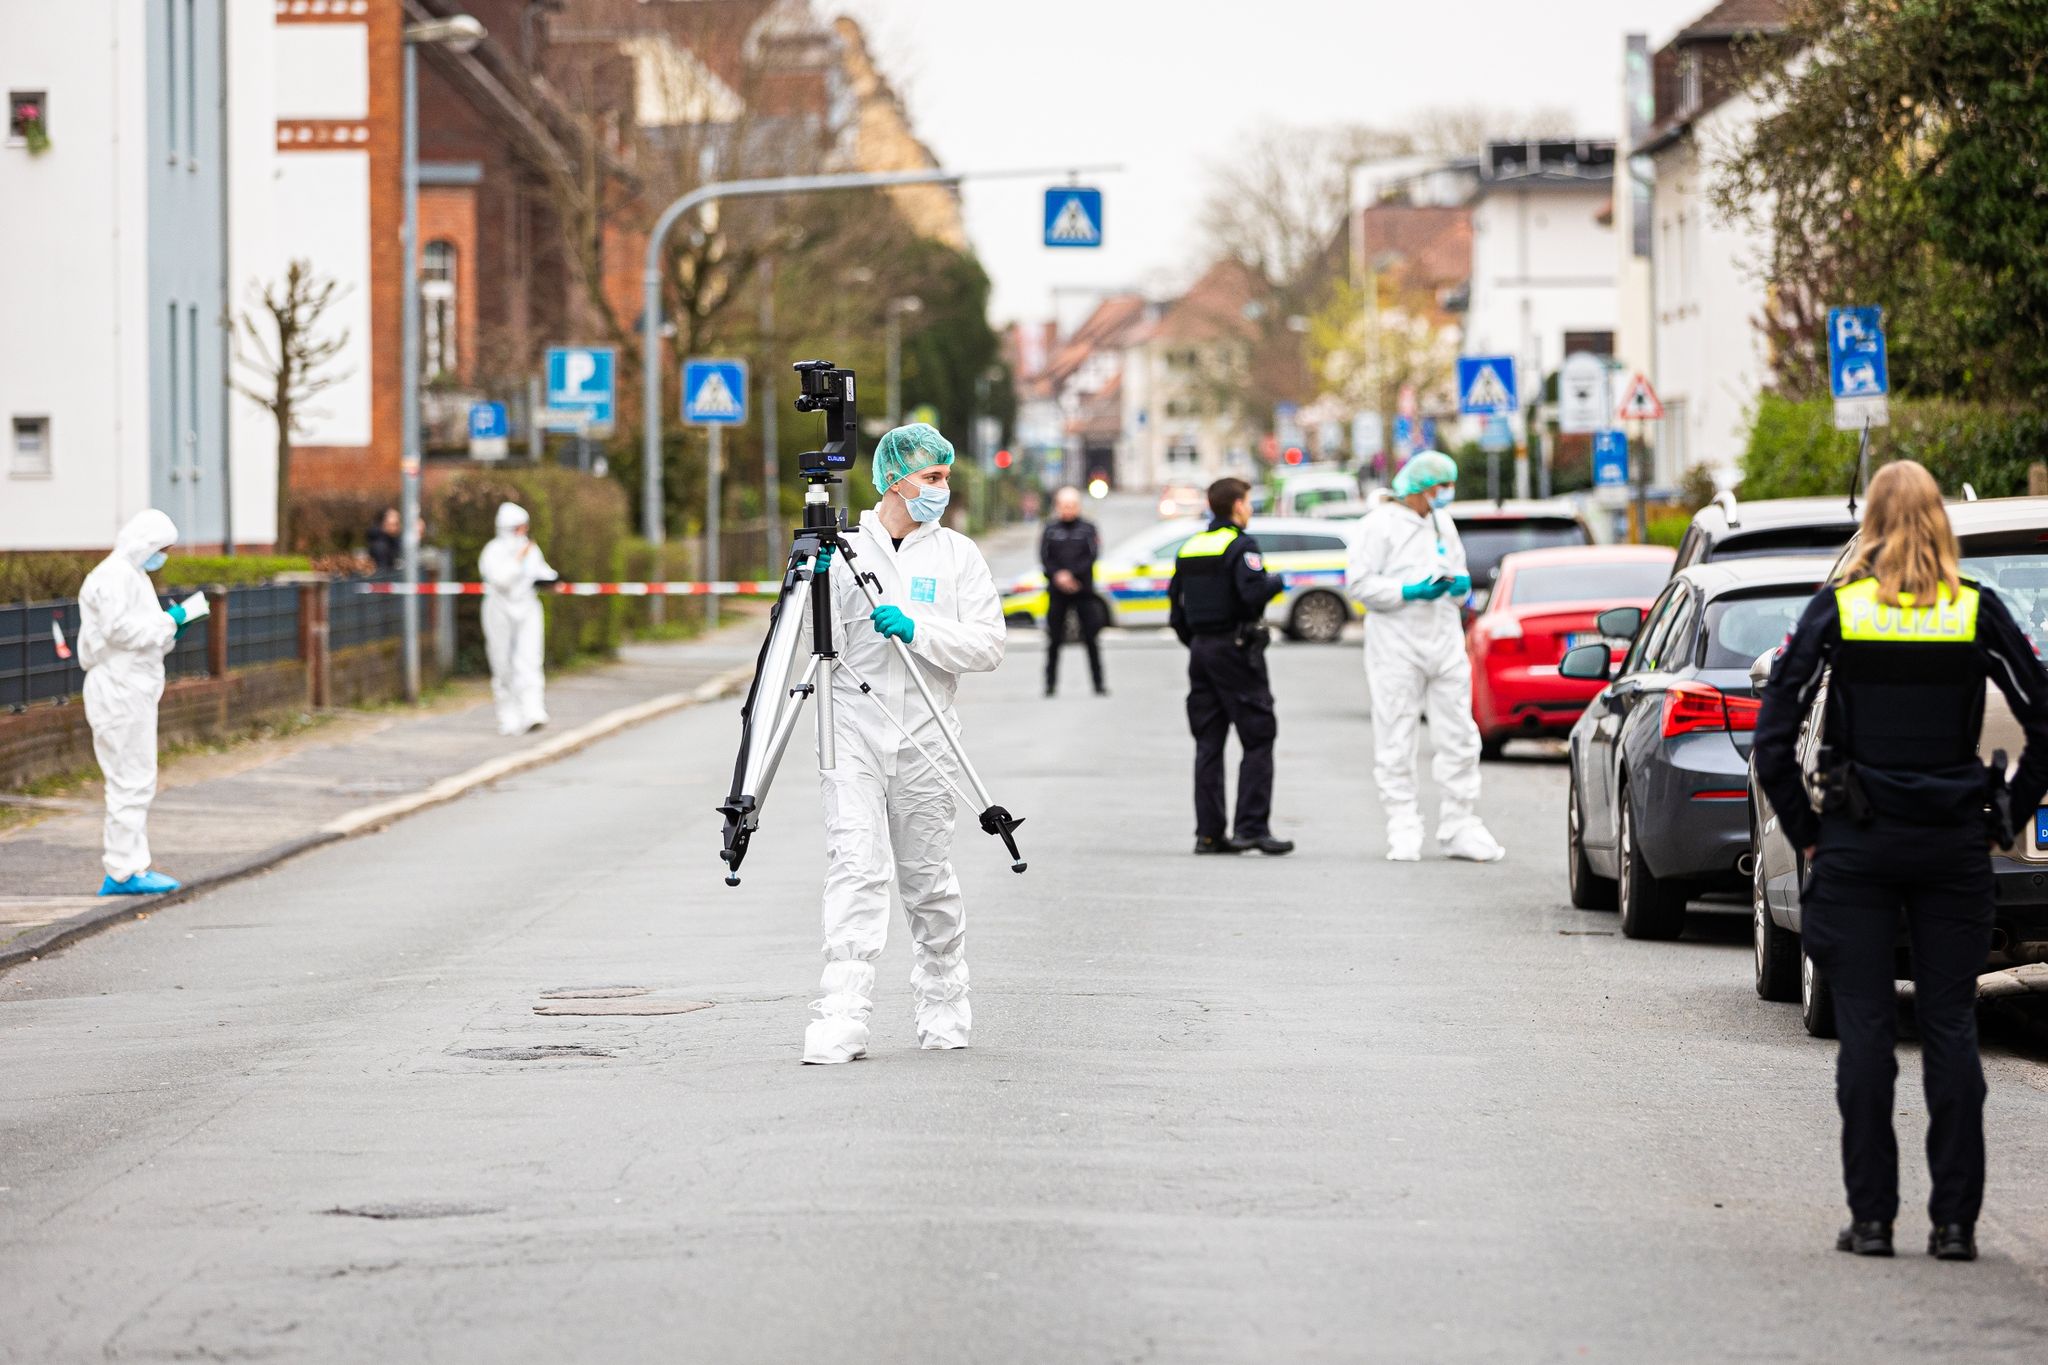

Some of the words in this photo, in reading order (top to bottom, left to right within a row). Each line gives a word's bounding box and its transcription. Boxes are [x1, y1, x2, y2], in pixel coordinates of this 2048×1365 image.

[565, 350, 596, 396] P
[1852, 599, 1966, 635] POLIZEI
[2042, 829, 2048, 838] D
